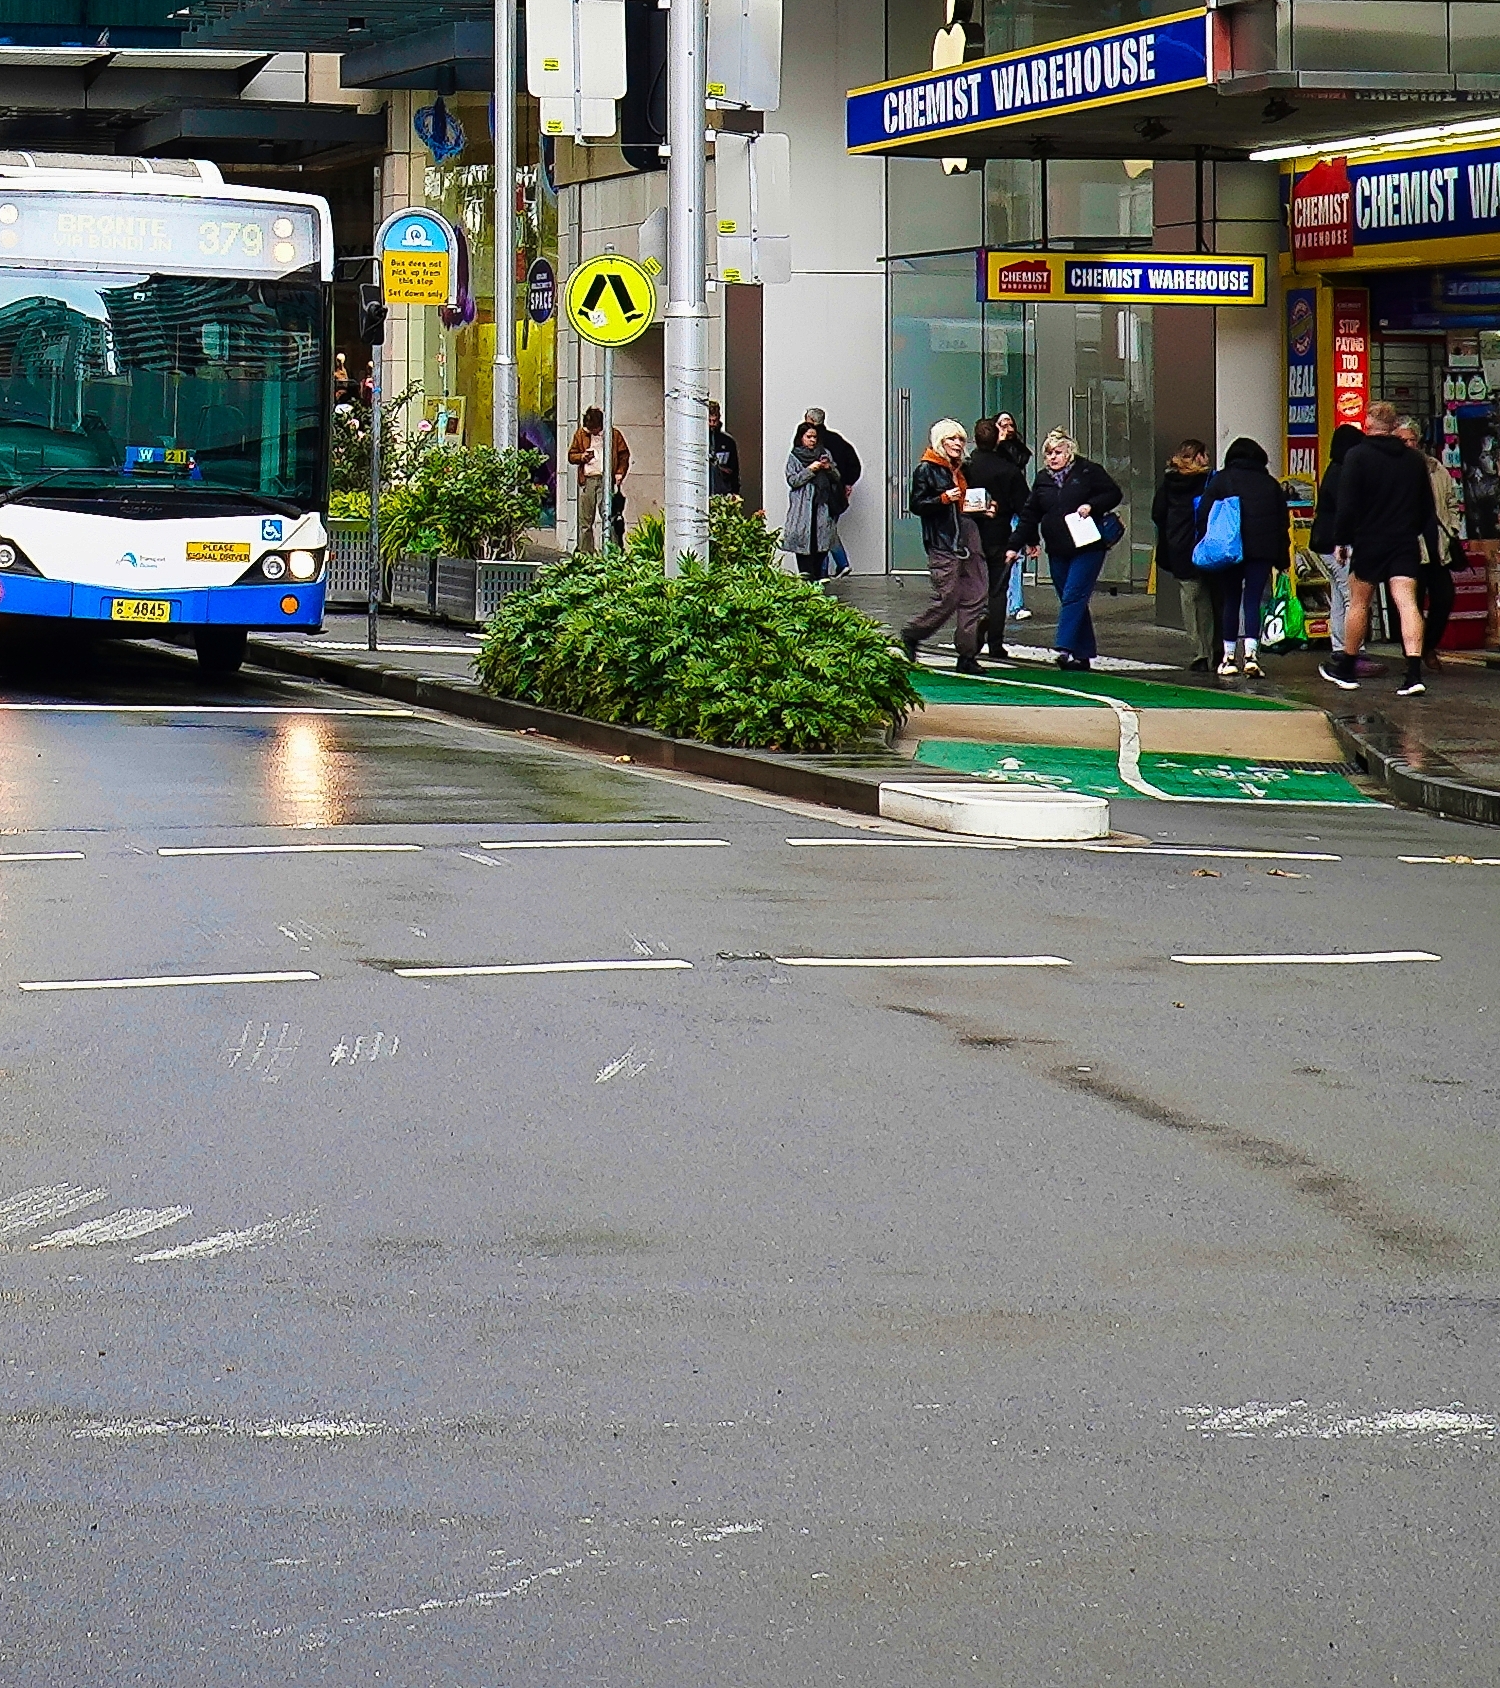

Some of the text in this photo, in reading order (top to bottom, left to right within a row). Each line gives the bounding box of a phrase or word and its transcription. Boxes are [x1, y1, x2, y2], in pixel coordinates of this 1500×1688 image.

[883, 33, 1157, 135] CHEMIST WAREHOUSE
[1355, 166, 1459, 230] CHEMIST
[1293, 192, 1350, 229] CHEMIST
[53, 232, 83, 248] VIA
[87, 233, 143, 251] BONDI
[199, 221, 264, 257] 379
[391, 268, 407, 277] pick
[1001, 267, 1250, 291] CHEMIST CHEMIST WAREHOUSE
[398, 277, 434, 286] this stop
[1338, 319, 1360, 334] STOP
[1335, 336, 1365, 352] PAYING
[1341, 354, 1359, 370] TOO
[1288, 364, 1316, 398] REAL
[202, 544, 235, 553] PLEASE
[219, 553, 250, 562] DRIVER
[133, 601, 166, 617] 4845
